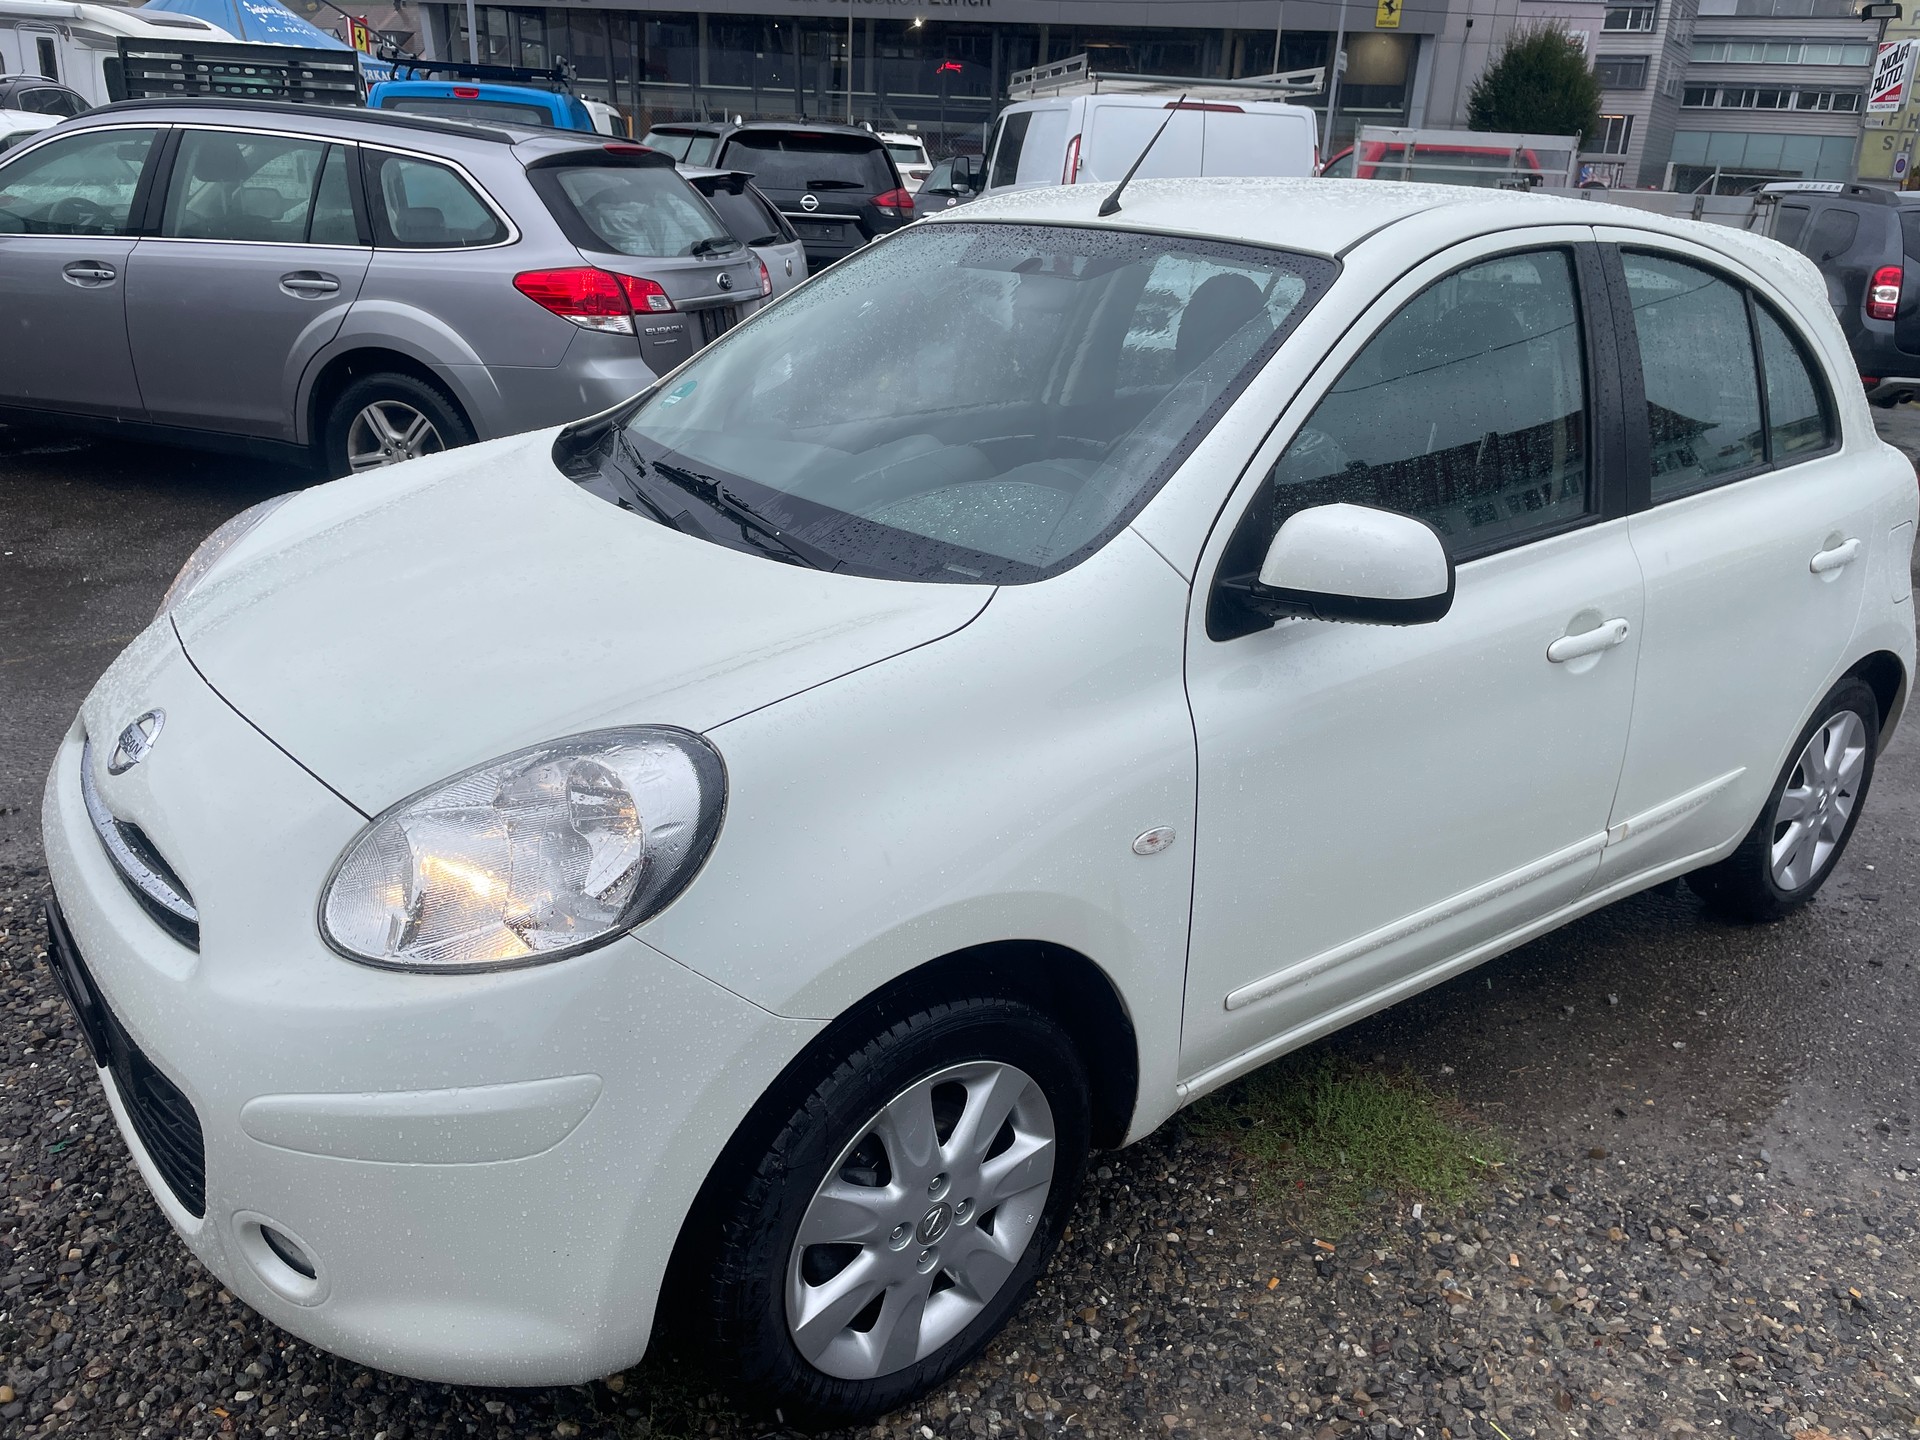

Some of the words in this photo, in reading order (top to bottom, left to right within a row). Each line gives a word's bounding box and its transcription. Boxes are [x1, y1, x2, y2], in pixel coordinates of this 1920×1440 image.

[1879, 42, 1911, 75] NOVA
[1870, 62, 1904, 99] AUTO
[1797, 183, 1841, 192] DUSTER
[645, 324, 684, 336] SUBARU
